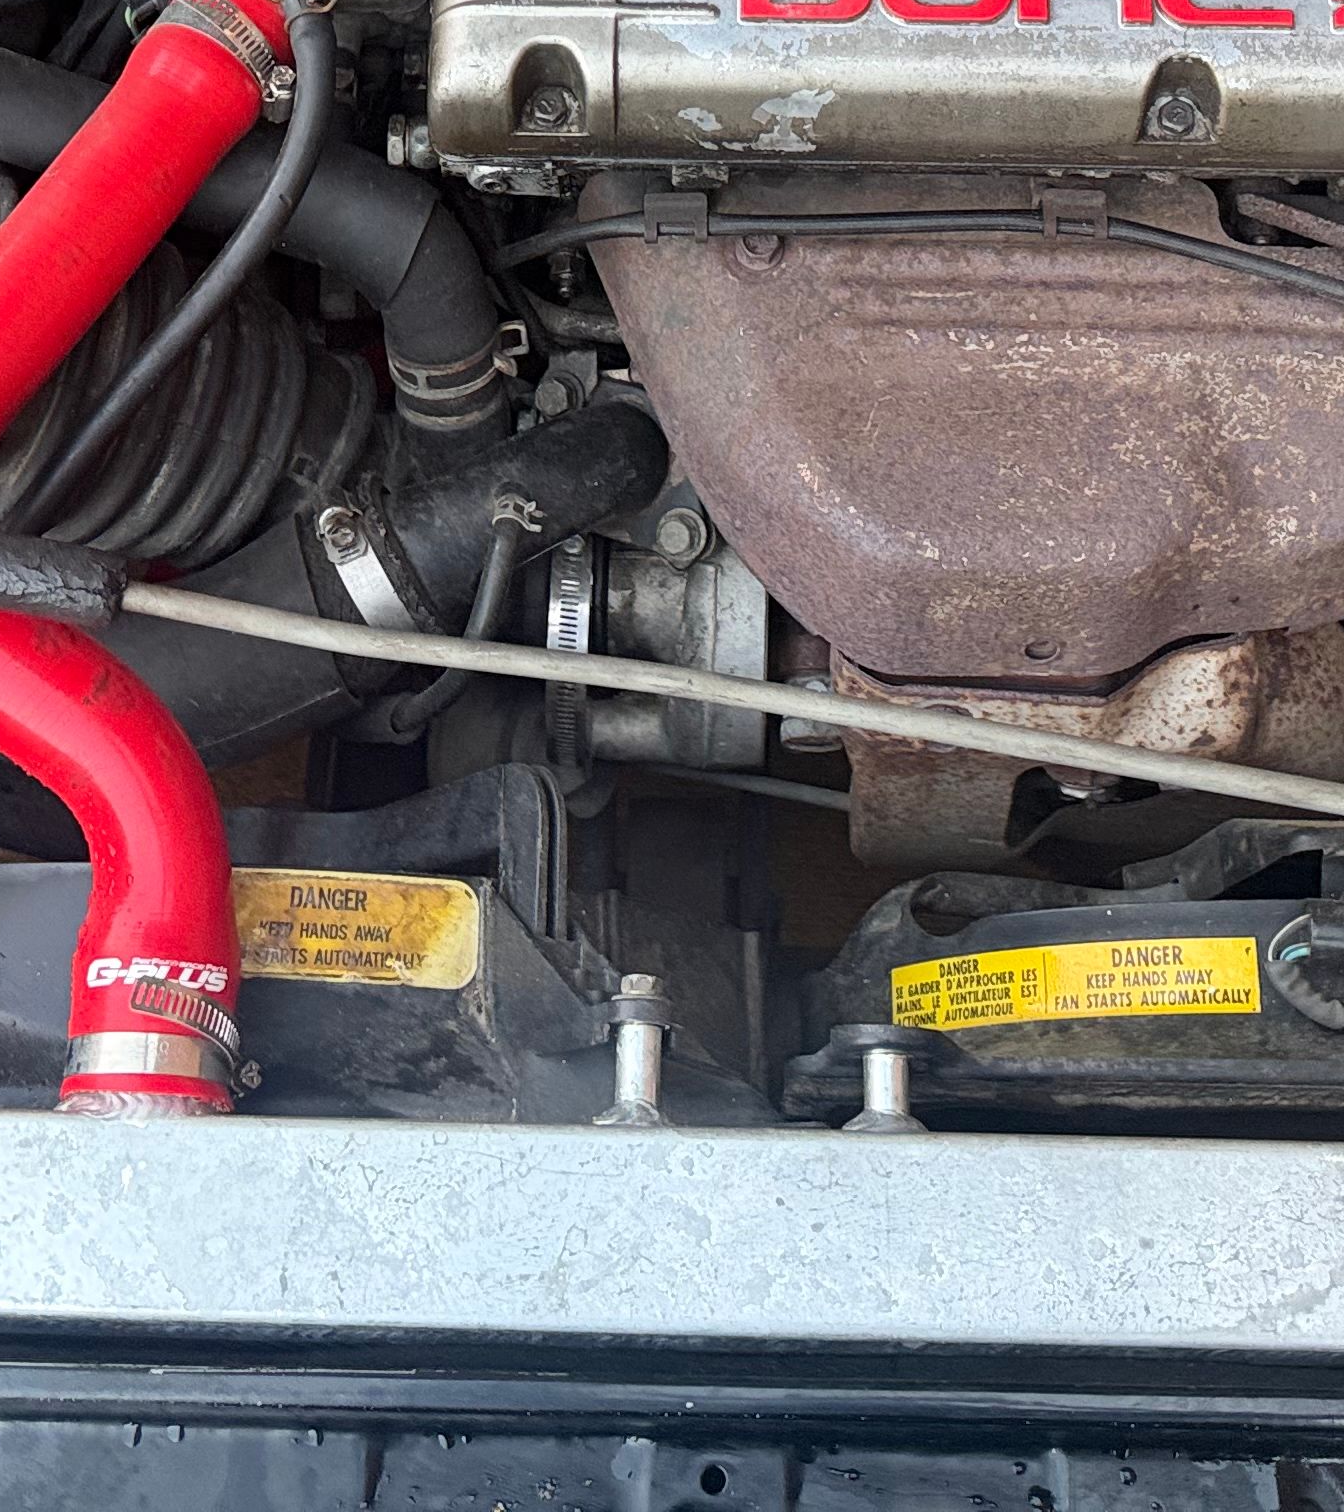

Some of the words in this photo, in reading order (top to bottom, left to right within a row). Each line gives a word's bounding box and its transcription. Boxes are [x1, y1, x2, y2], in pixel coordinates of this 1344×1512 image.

[289, 885, 367, 912] DANGER
[299, 922, 348, 941] HANDS
[354, 924, 393, 943] AWAY
[939, 958, 980, 978] DANGER
[1112, 945, 1184, 968] DANGER
[86, 956, 229, 993] G-PLUS
[206, 963, 228, 974] Parts
[1086, 973, 1116, 989] KEEP
[1122, 970, 1168, 987] HANDS
[1175, 969, 1213, 985] AWAY
[895, 985, 904, 1000] SE
[908, 980, 942, 996] GARDER
[946, 970, 1016, 992] D'APPROCHER
[1021, 968, 1038, 982] LES
[896, 1000, 925, 1015] MAINS.
[932, 994, 941, 1009] LE
[948, 986, 1012, 1006] VENTILATEUR
[1020, 984, 1038, 998] EST
[1055, 994, 1080, 1011] FAN
[1086, 991, 1133, 1009] STARTS
[1140, 988, 1252, 1007] AUTOMATICALLY
[944, 1002, 1015, 1023] AUTOMATIQUE
